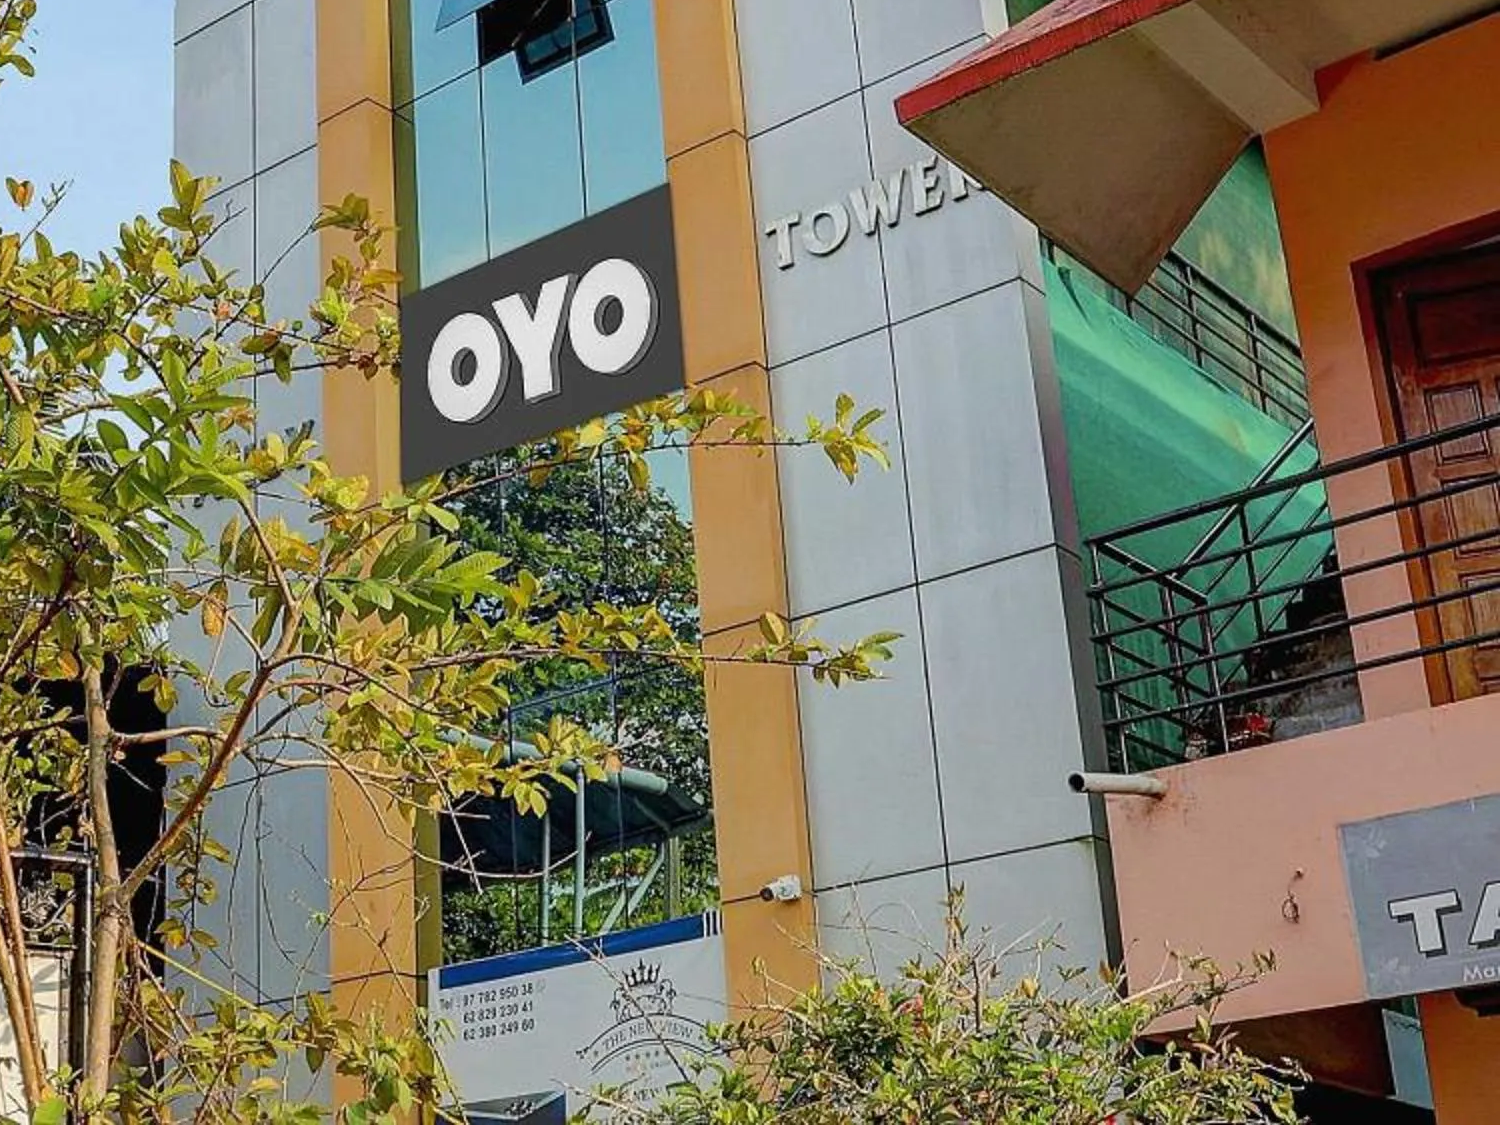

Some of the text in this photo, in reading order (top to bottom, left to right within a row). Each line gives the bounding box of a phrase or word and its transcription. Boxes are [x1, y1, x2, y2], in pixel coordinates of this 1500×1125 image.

[427, 257, 659, 424] OYO
[1463, 962, 1500, 982] Ma
[603, 1030, 627, 1051] THE
